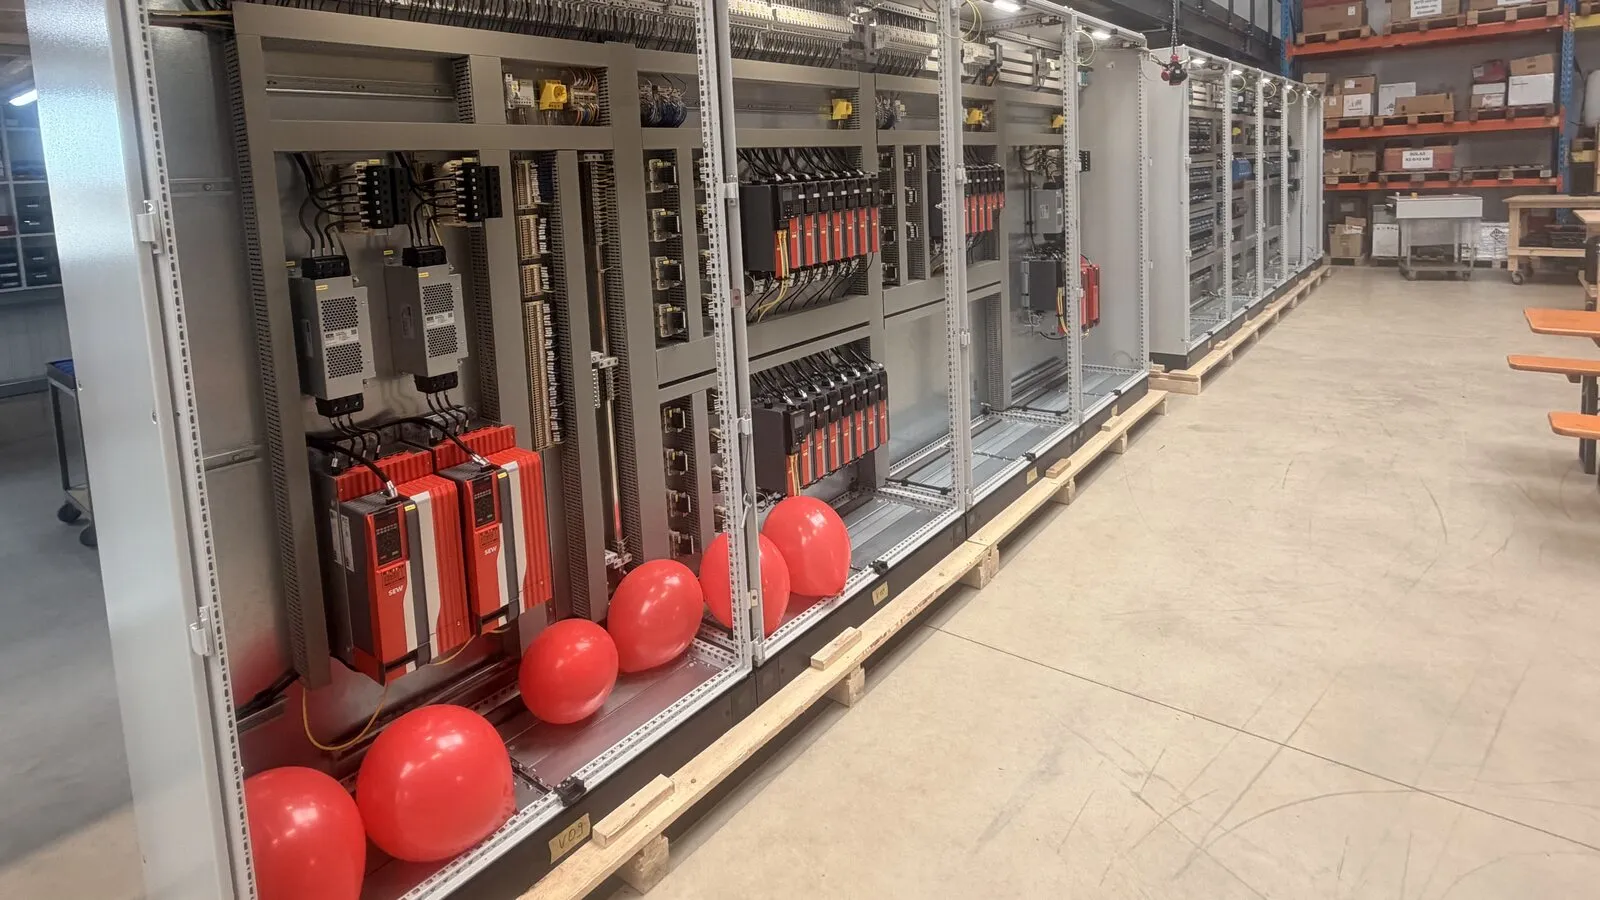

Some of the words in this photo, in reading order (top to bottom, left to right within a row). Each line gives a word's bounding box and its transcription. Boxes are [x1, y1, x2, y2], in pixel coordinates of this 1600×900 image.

[484, 545, 497, 556] SEW
[388, 585, 404, 597] SEW
[558, 821, 584, 849] V09
